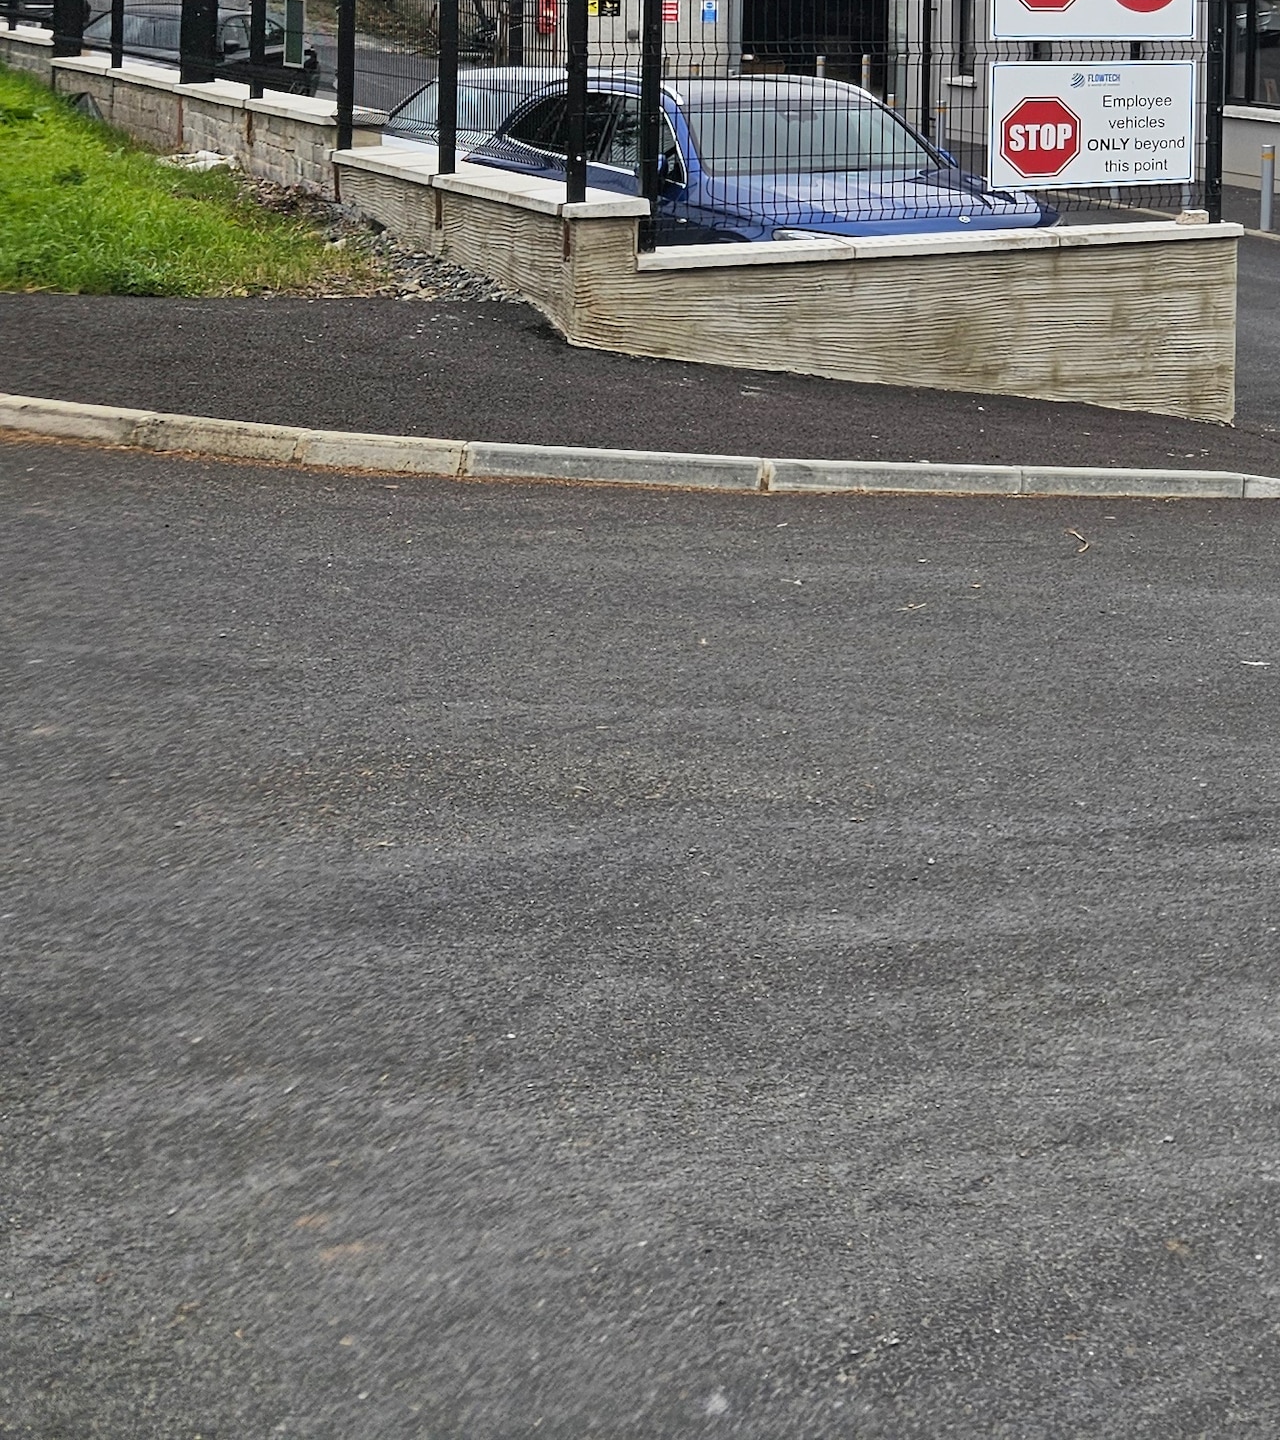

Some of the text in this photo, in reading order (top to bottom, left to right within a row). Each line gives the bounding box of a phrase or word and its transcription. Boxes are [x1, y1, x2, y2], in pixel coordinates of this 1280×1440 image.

[1088, 73, 1120, 82] FLOWTECH
[1102, 94, 1172, 110] Employee
[1108, 115, 1165, 129] vehicles
[1009, 123, 1072, 152] STOP
[1087, 136, 1185, 153] ONLY beyond
[1105, 158, 1168, 174] this point
